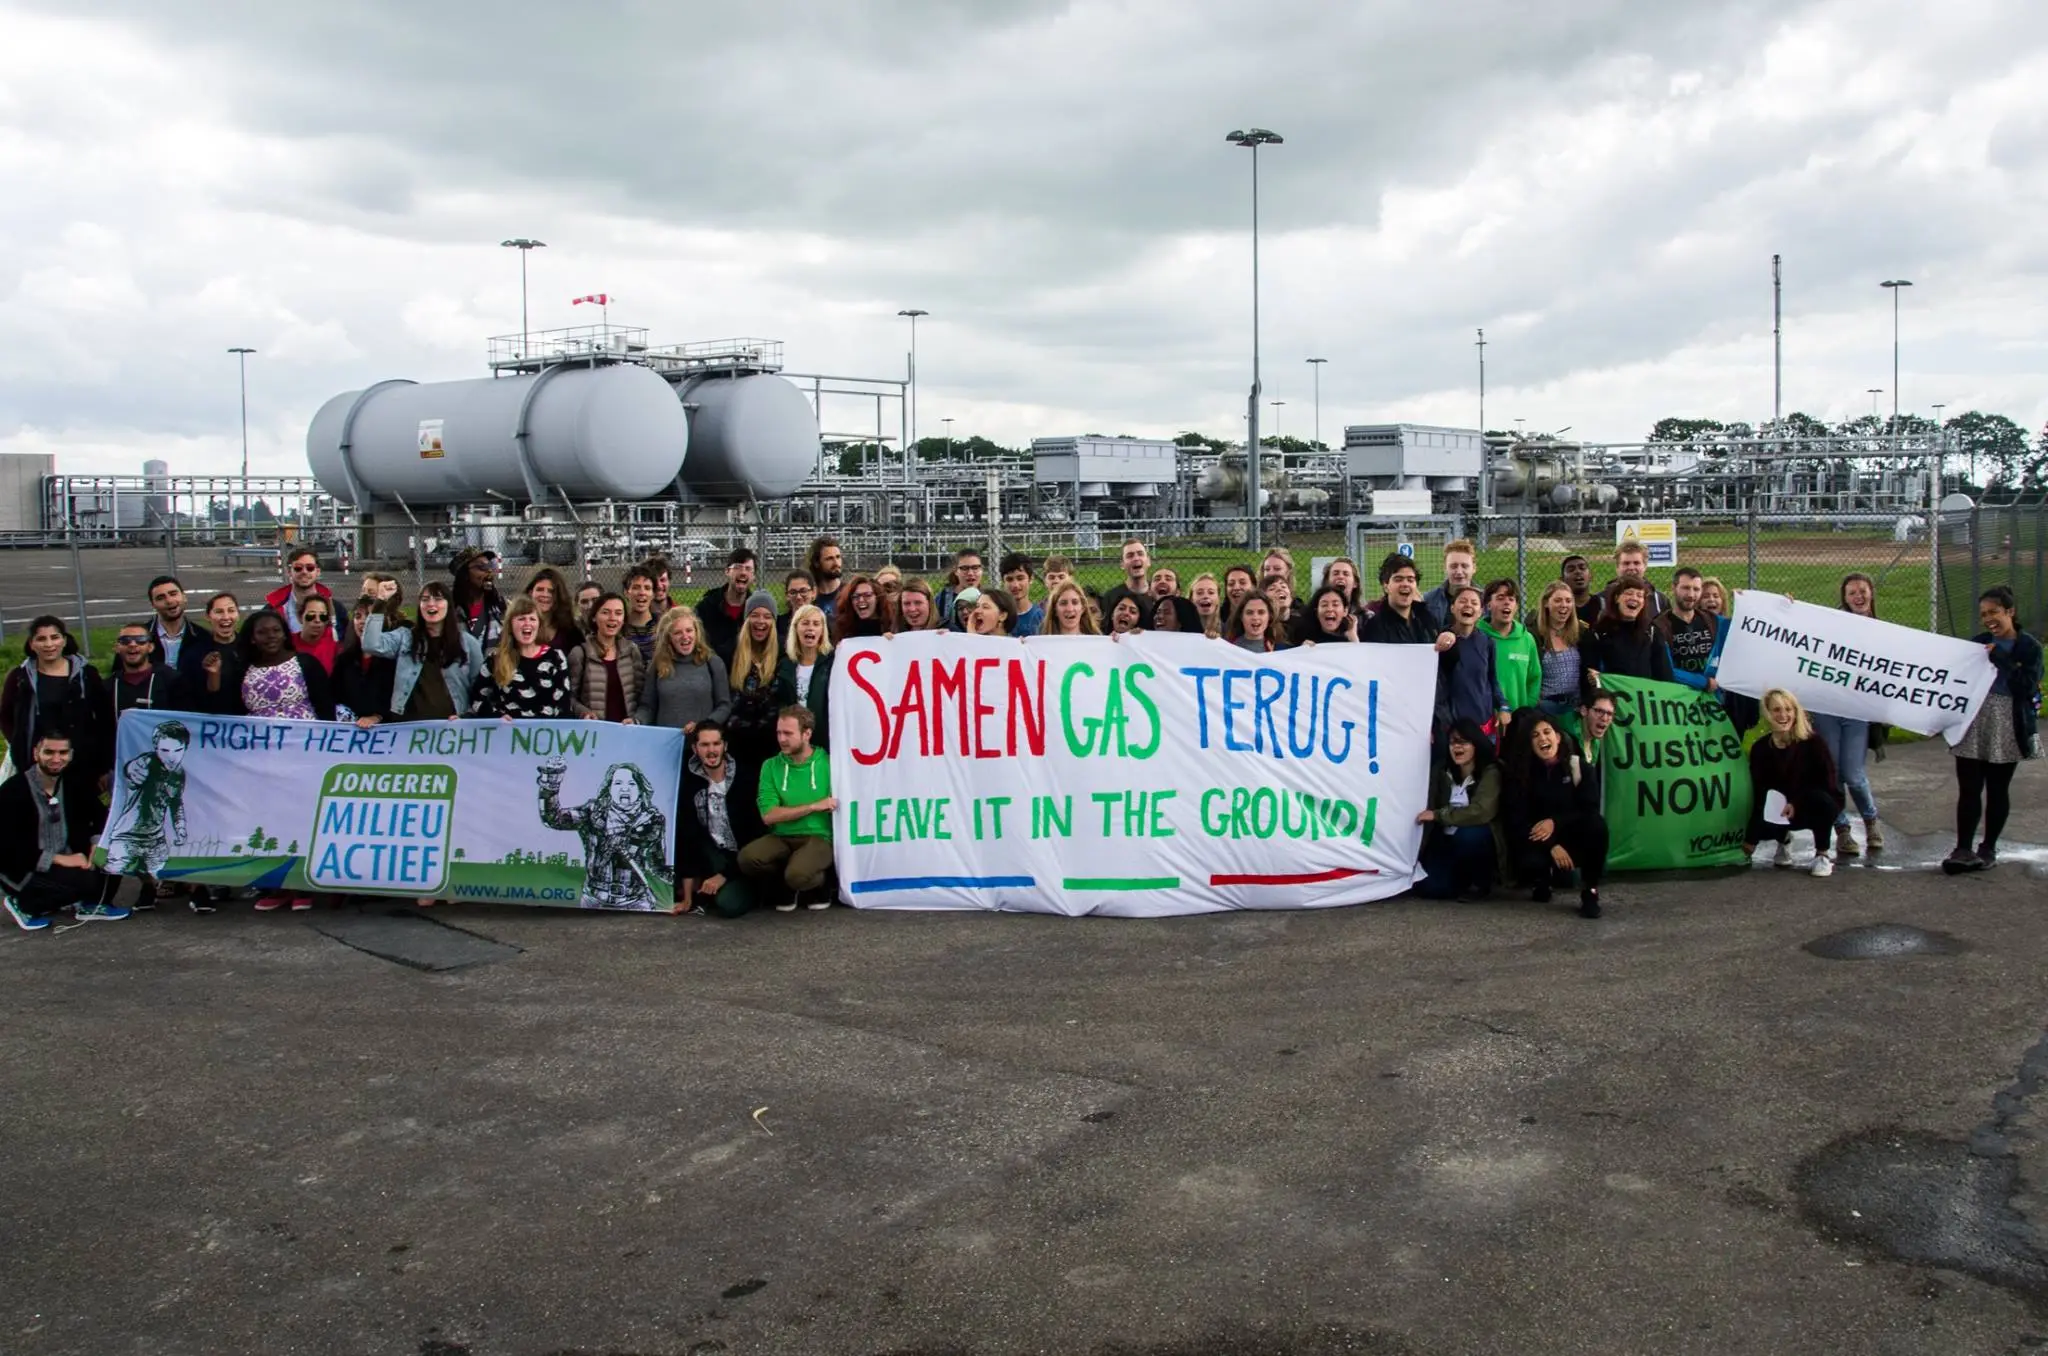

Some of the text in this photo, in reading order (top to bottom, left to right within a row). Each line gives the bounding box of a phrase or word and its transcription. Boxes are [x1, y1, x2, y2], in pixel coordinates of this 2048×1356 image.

[1741, 616, 1825, 654] КЛИМАТ
[1827, 642, 1950, 686] МЕНЯЕТСЯ
[1796, 656, 1970, 714] ТЕБЯ КАСАЕТСЯ
[847, 650, 1380, 775] SAMEN GAS TERUG!
[200, 721, 597, 757] RIGHT HERE! RIGHT NOW!
[1612, 731, 1741, 770] Justice
[330, 772, 448, 795] JONGEREN
[1637, 772, 1731, 817] NOW
[322, 801, 444, 839] MILIEU
[850, 786, 1378, 848] LEAVE IT IN THE GROUND!
[315, 842, 439, 882] ACTIEF
[454, 885, 576, 901] WWW.JMA.ORG
